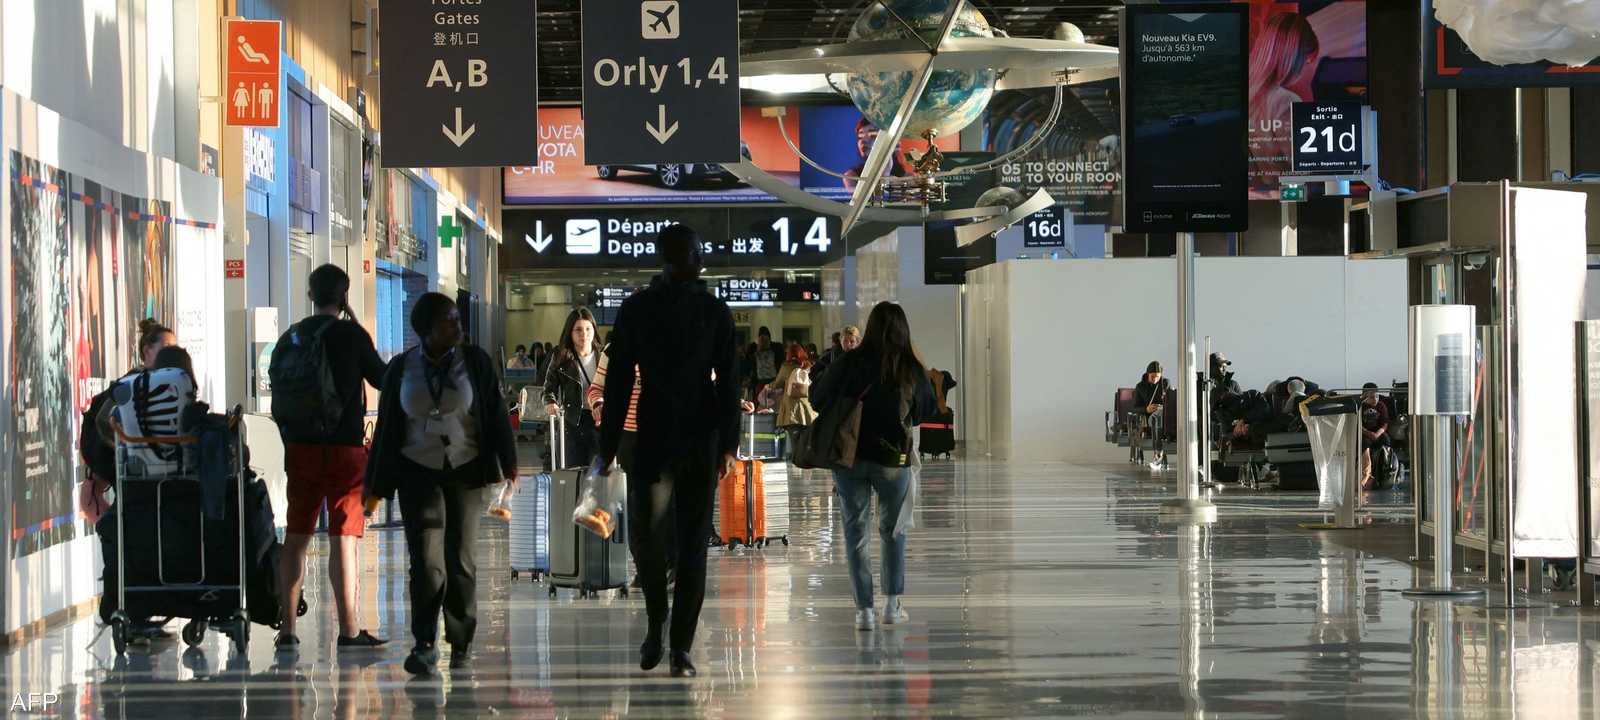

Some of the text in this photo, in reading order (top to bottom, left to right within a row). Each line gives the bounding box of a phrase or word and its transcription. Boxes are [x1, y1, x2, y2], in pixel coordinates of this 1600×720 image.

[434, 11, 480, 25] Gates
[433, 31, 479, 46] 登机口
[1142, 33, 1217, 42] Nouveau Kia EV9.
[1174, 44, 1190, 52] 563
[1192, 43, 1205, 52] km
[426, 59, 488, 93] A,B
[593, 56, 729, 94] Orly 1,4
[1260, 119, 1282, 132] UP
[1300, 124, 1356, 153] 21d
[1001, 163, 1021, 175] 05
[1026, 161, 1108, 172] TO CONNECT
[1002, 175, 1021, 183] MINS
[1026, 173, 1043, 183] TO
[1047, 173, 1083, 183] YOUR
[1028, 219, 1060, 238] 16d
[771, 216, 832, 256] 1,4
[732, 238, 764, 254] 出发
[739, 279, 768, 290] Orly 4
